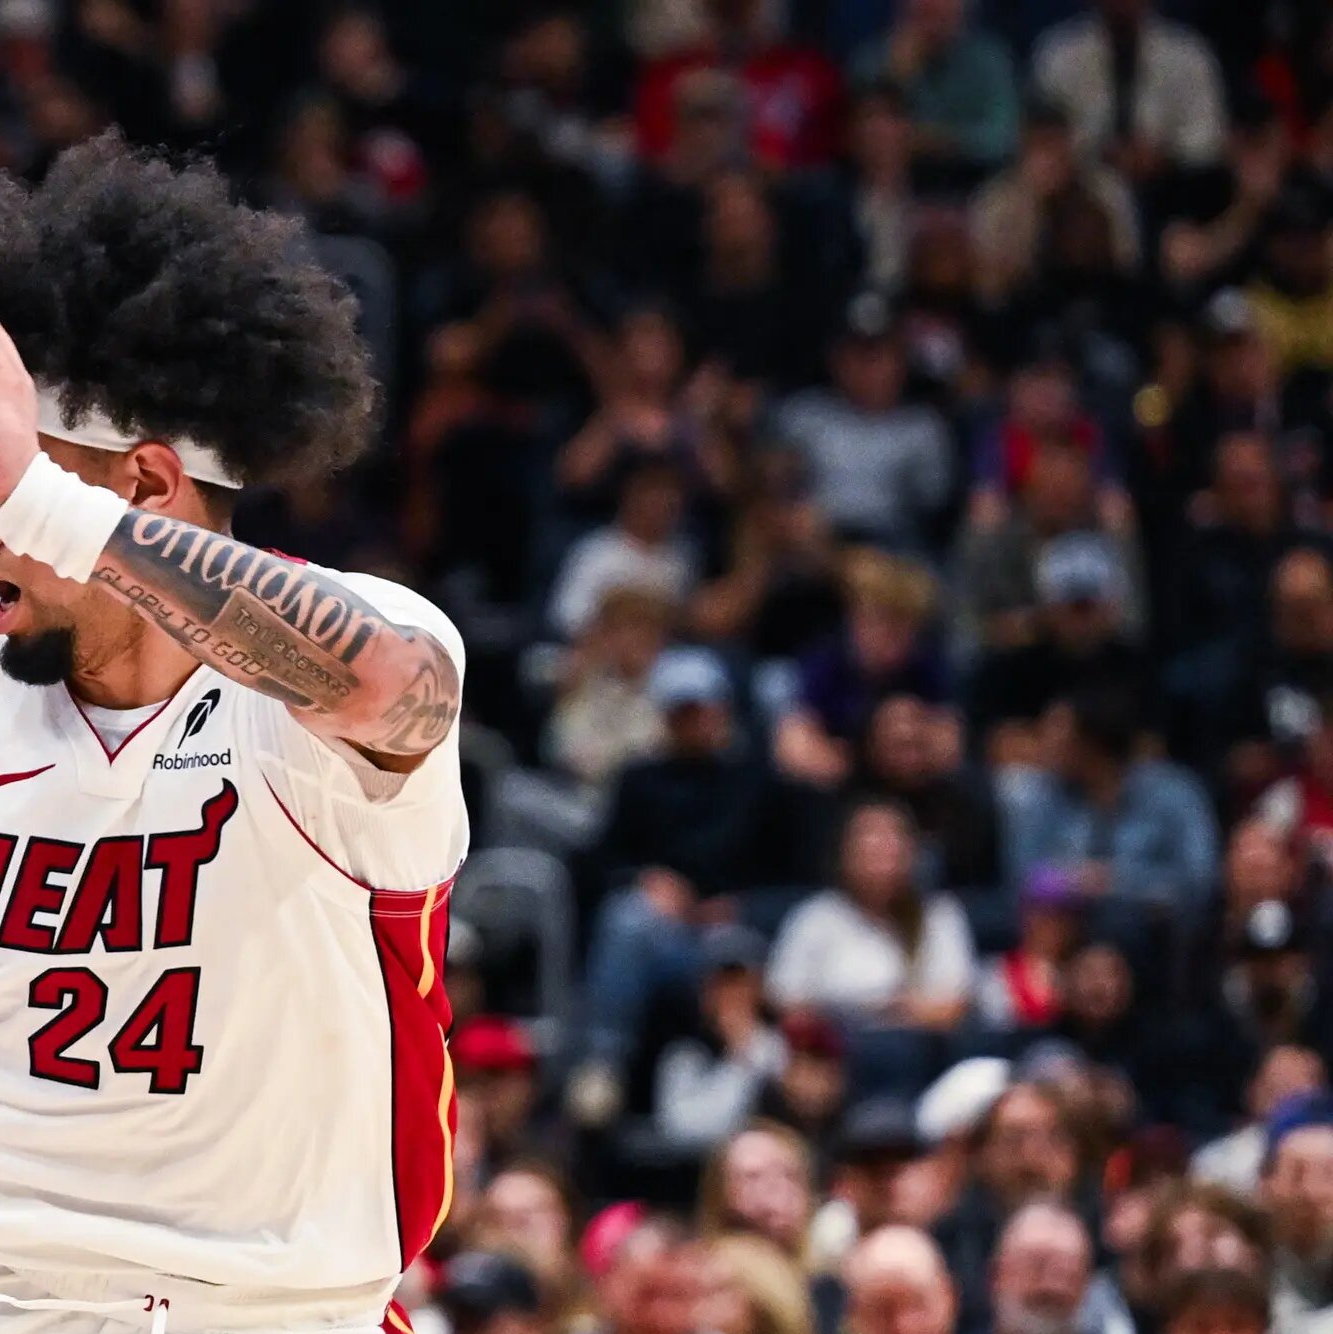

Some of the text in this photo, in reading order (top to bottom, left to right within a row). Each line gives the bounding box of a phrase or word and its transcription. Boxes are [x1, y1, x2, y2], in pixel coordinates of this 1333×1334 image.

[213, 637, 266, 676] GOD
[152, 748, 232, 770] Robinhood
[27, 966, 205, 1095] 24
